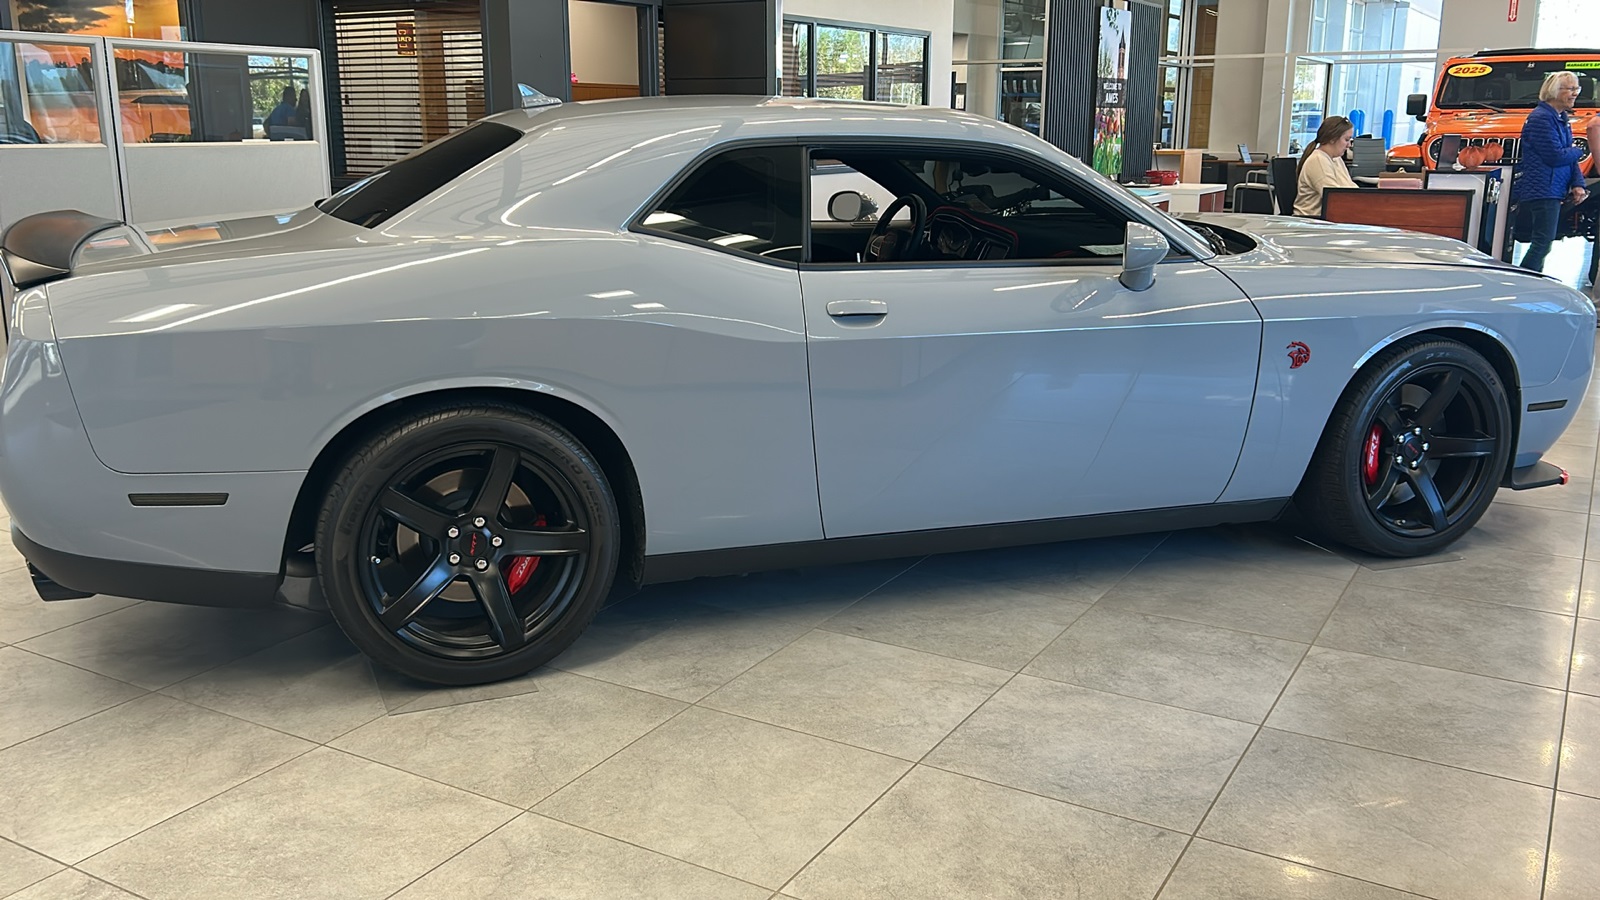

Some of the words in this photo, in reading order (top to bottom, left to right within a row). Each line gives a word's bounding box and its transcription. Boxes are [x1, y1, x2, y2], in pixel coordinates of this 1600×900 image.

[1453, 66, 1488, 74] 2025
[1103, 82, 1117, 90] WELCOME
[1105, 92, 1118, 104] AMES
[1368, 430, 1379, 467] SRT
[469, 532, 477, 556] SRT
